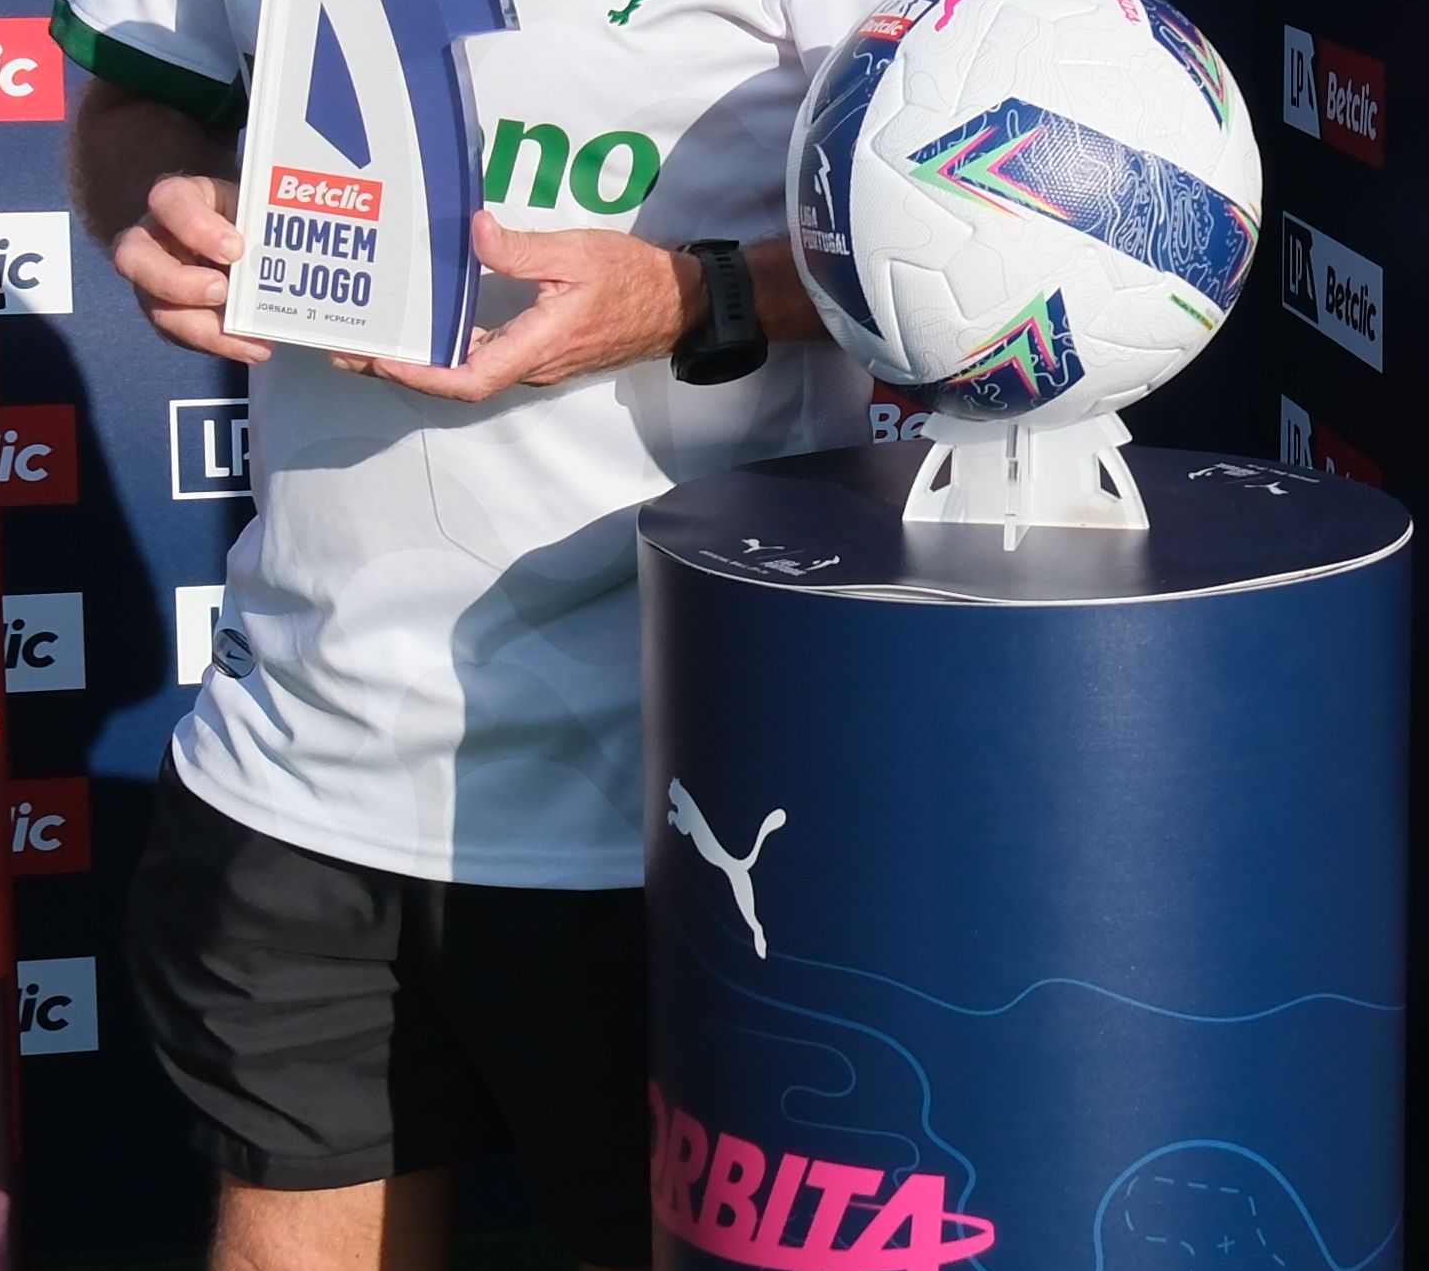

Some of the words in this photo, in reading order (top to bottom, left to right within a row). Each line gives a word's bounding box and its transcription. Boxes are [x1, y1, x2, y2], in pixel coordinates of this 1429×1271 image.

[1290, 47, 1304, 108] LP
[1326, 71, 1379, 141] Betclic
[482, 118, 661, 216] no
[276, 174, 374, 213] Betclic
[263, 211, 378, 263] HOMEM
[259, 256, 287, 283] DO
[289, 263, 372, 307] JOGO
[1289, 234, 1302, 296] LP
[1325, 264, 1377, 342] Betclic
[256, 302, 298, 316] JORNADA
[306, 308, 317, 321] 31
